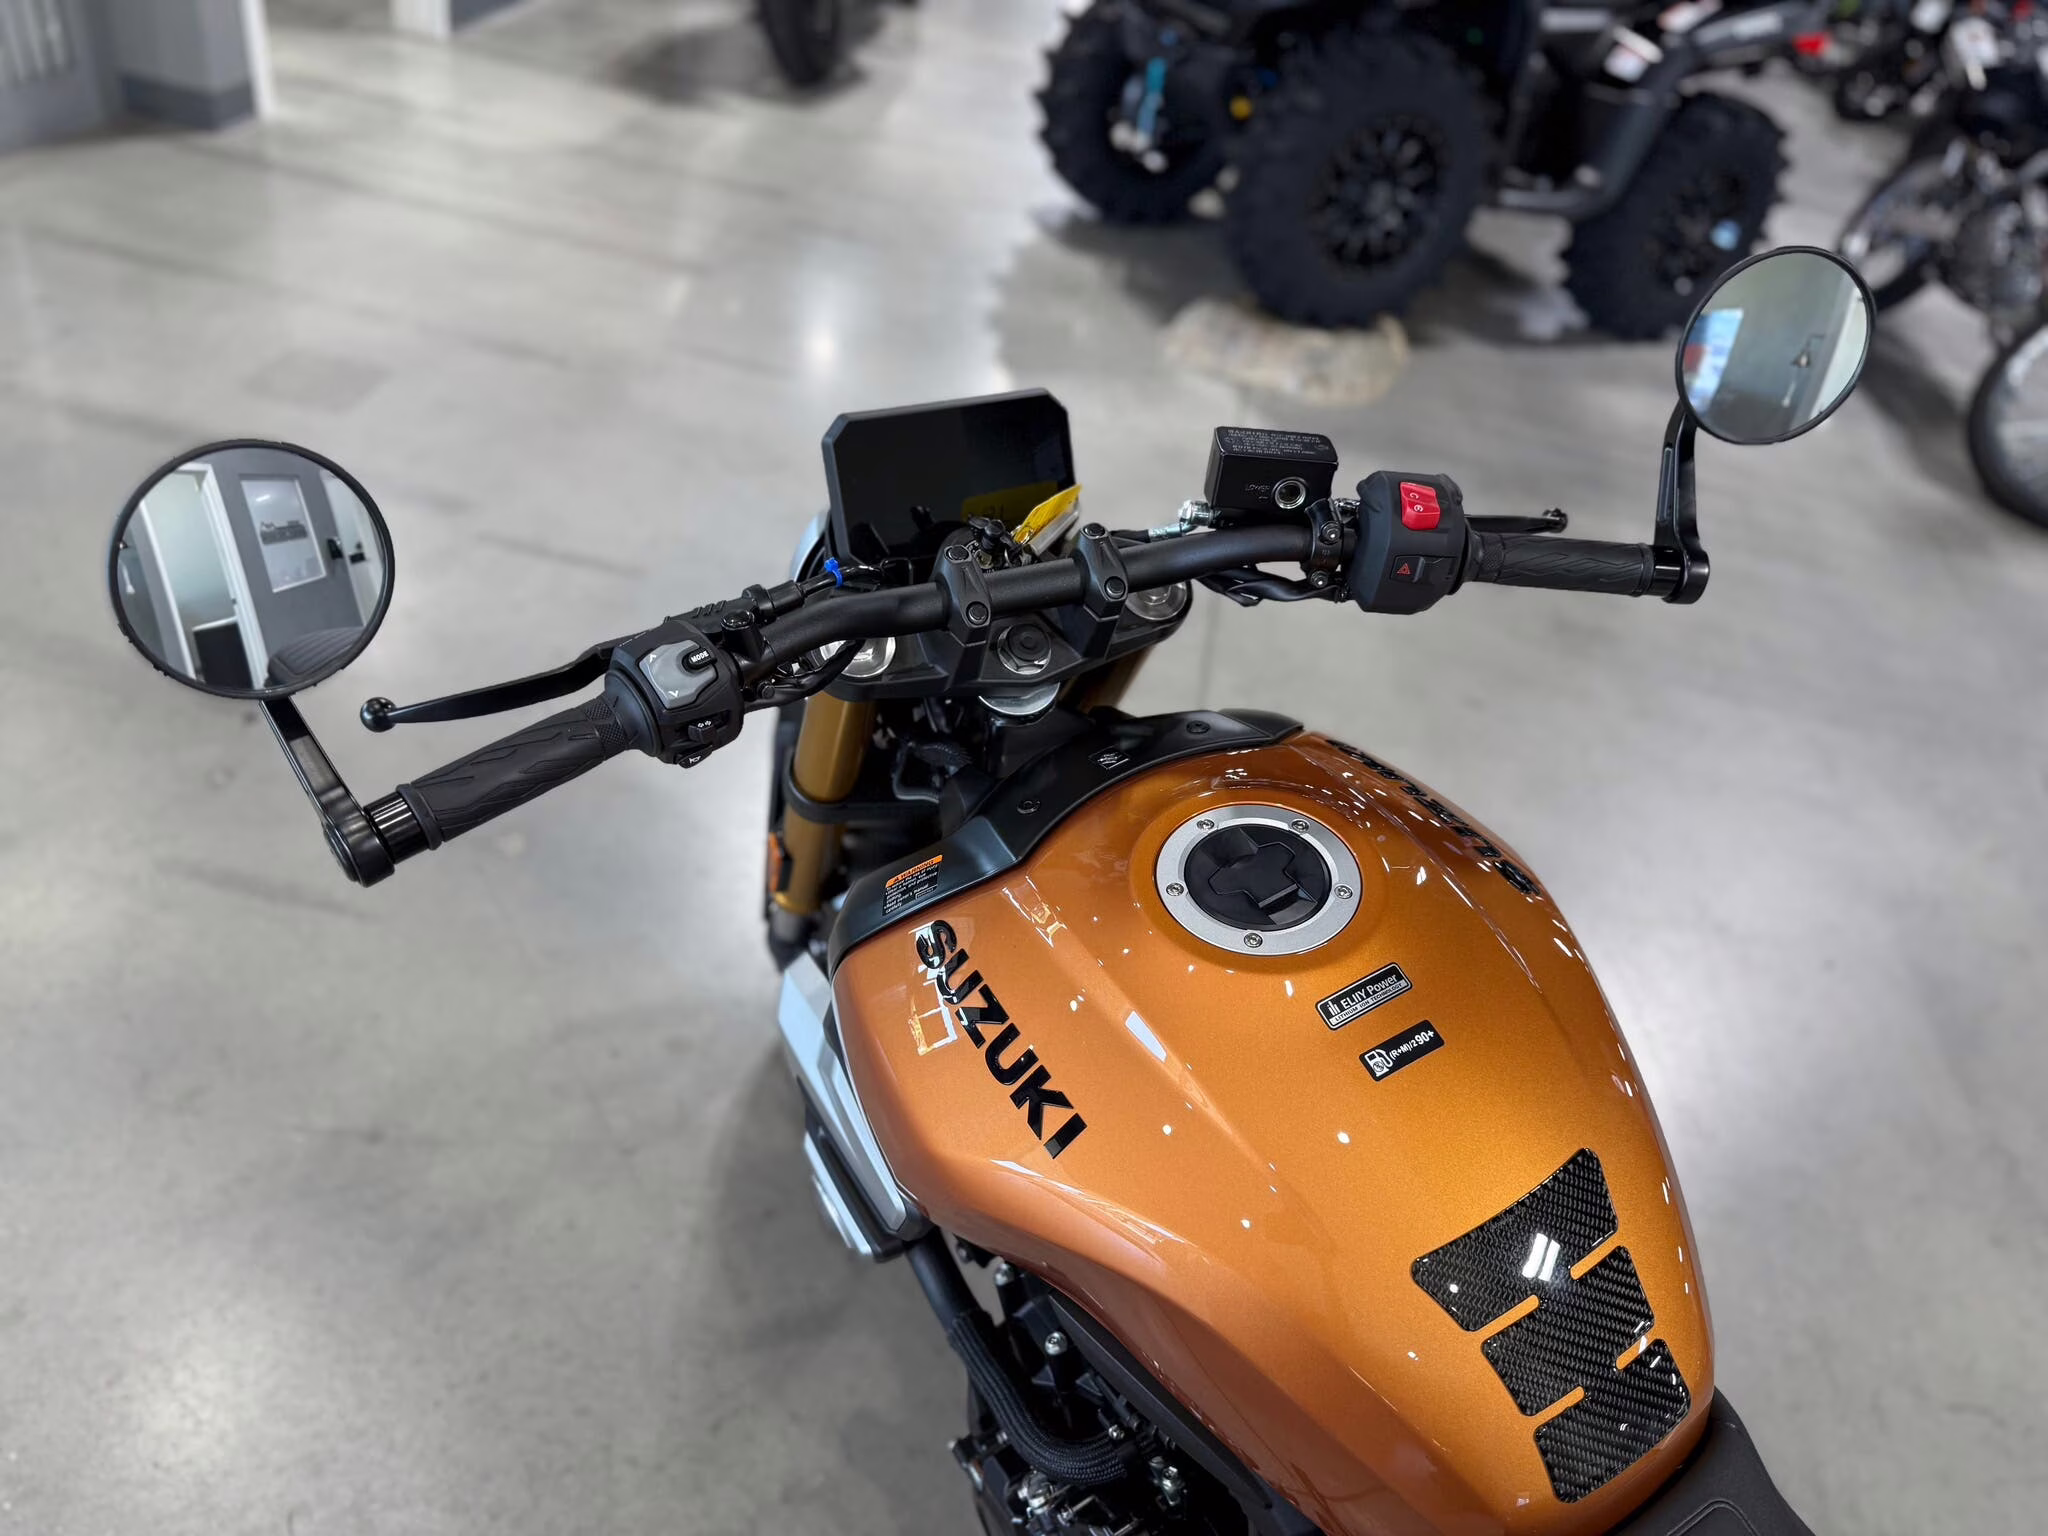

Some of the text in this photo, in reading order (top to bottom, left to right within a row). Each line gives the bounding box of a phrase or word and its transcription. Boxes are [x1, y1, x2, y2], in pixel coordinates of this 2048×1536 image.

[690, 650, 709, 663] MODE
[1366, 974, 1398, 996] Power
[915, 919, 1088, 1160] SUZUKI
